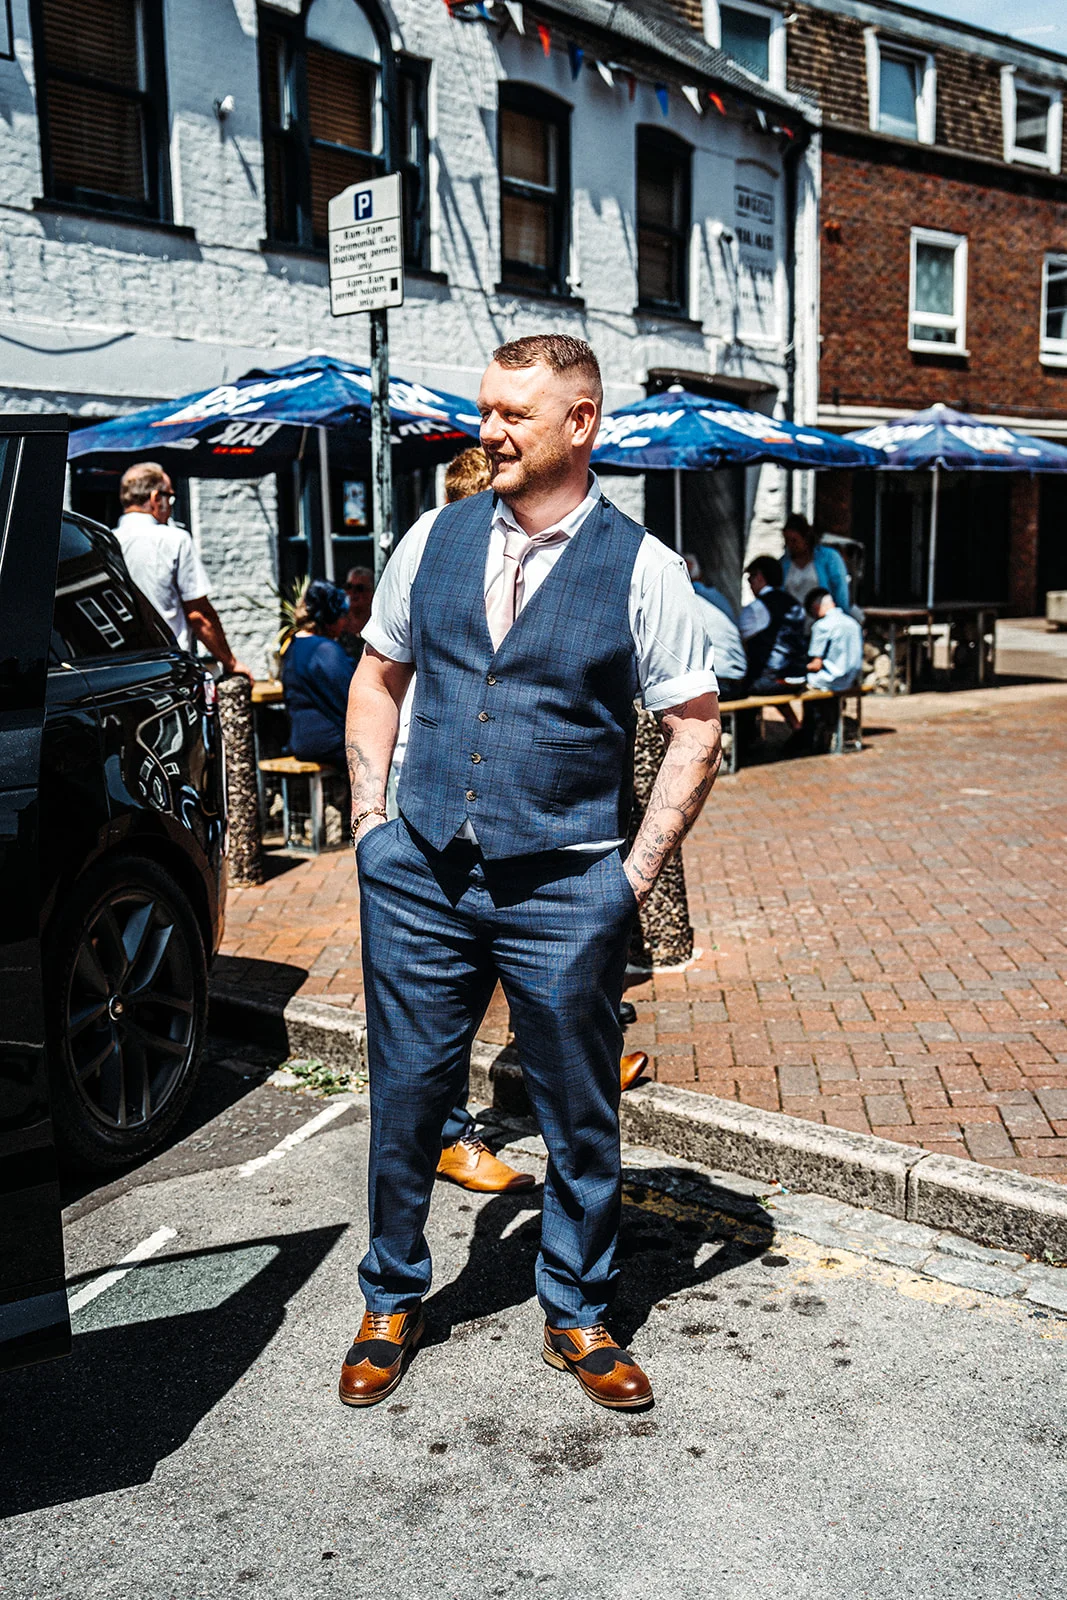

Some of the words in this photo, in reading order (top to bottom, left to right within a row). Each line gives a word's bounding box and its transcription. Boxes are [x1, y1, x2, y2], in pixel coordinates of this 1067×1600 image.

[358, 193, 370, 218] P
[379, 234, 397, 244] cars
[333, 251, 367, 264] displaying
[370, 244, 398, 257] permits
[358, 261, 373, 270] only
[334, 289, 357, 300] permit
